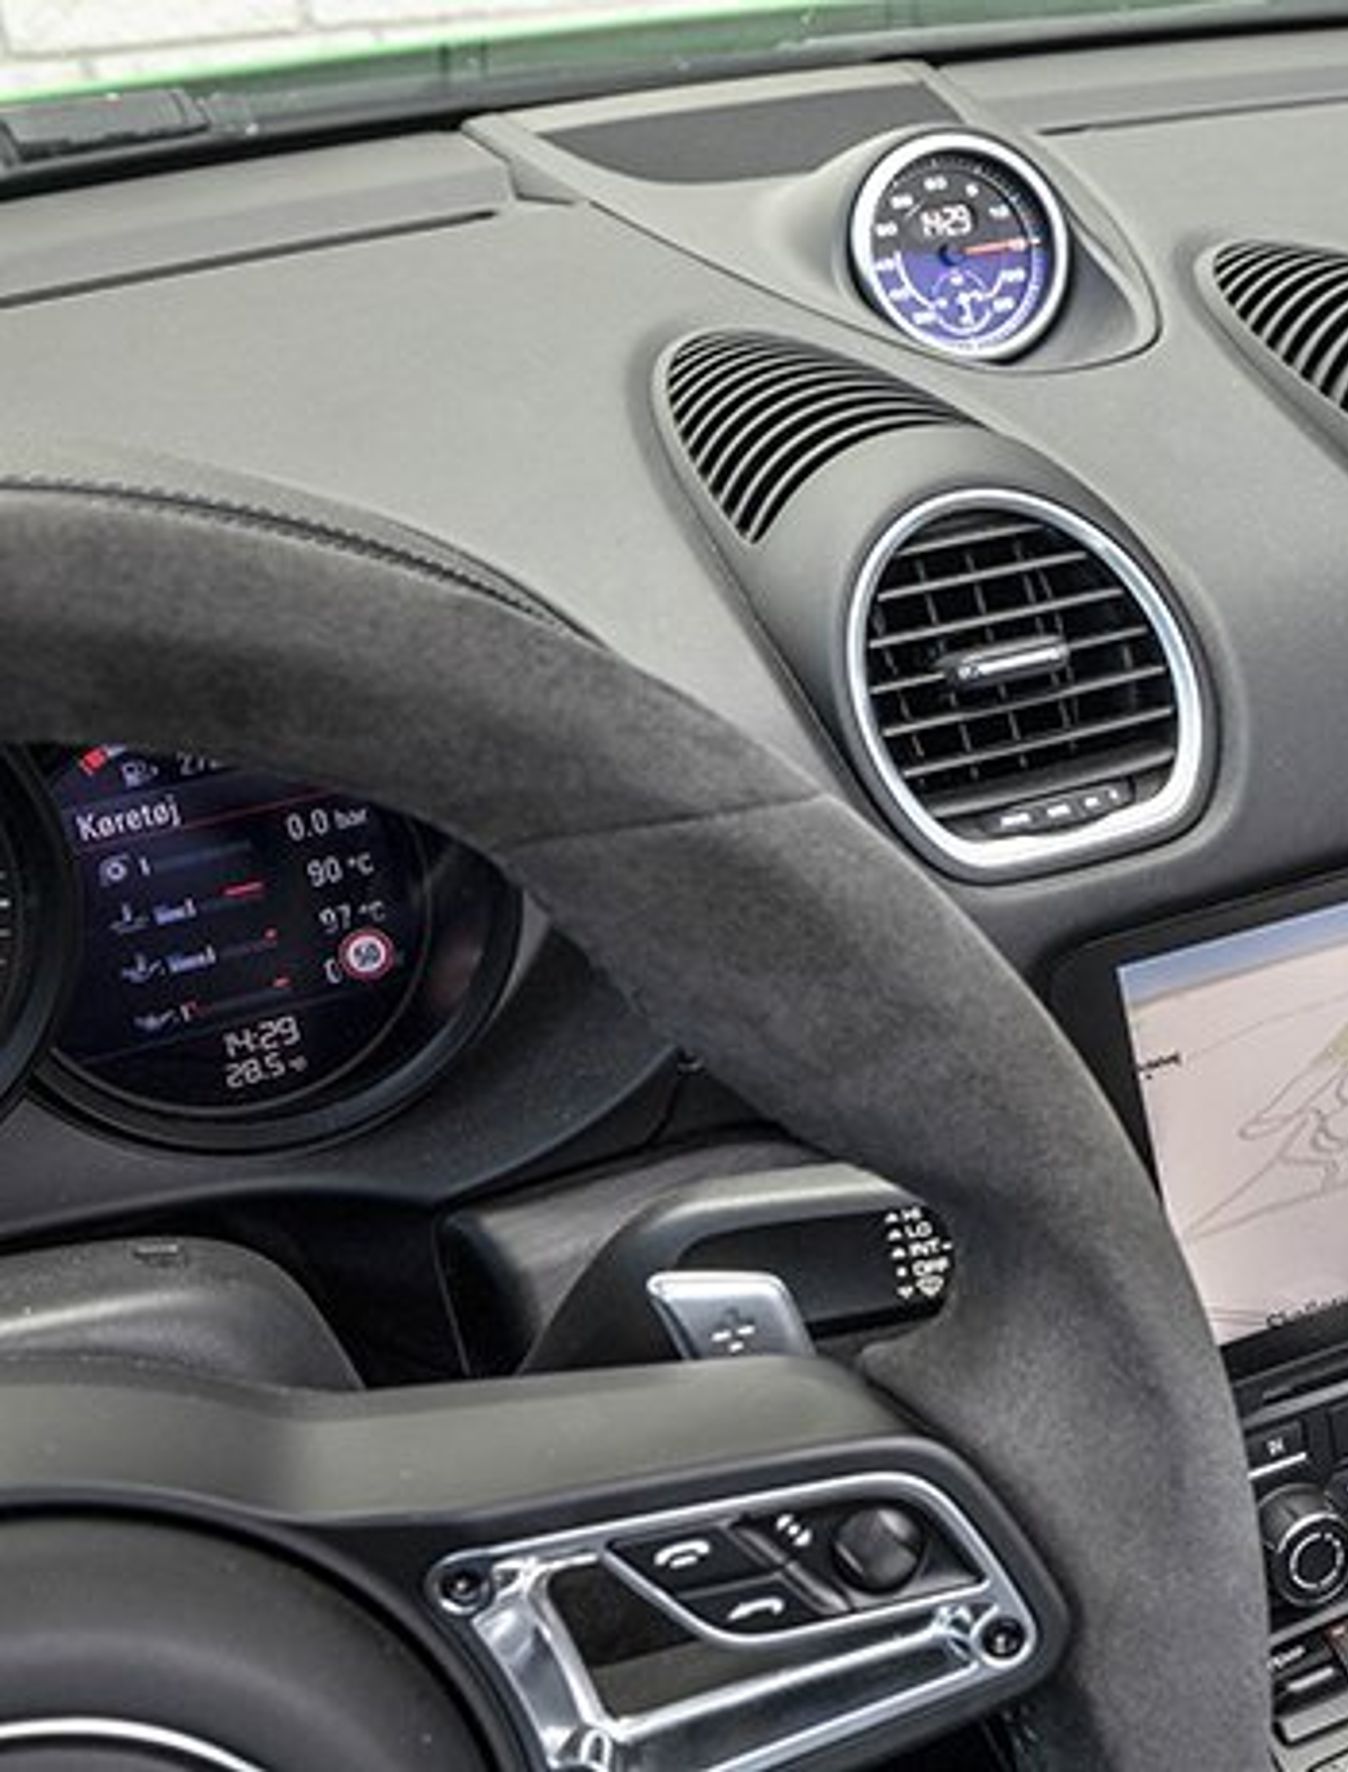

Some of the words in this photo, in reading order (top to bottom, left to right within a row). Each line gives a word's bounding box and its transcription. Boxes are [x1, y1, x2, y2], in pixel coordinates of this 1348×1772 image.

[286, 809, 329, 842] 0.0
[307, 856, 343, 888] 90
[904, 1220, 933, 1239] LO
